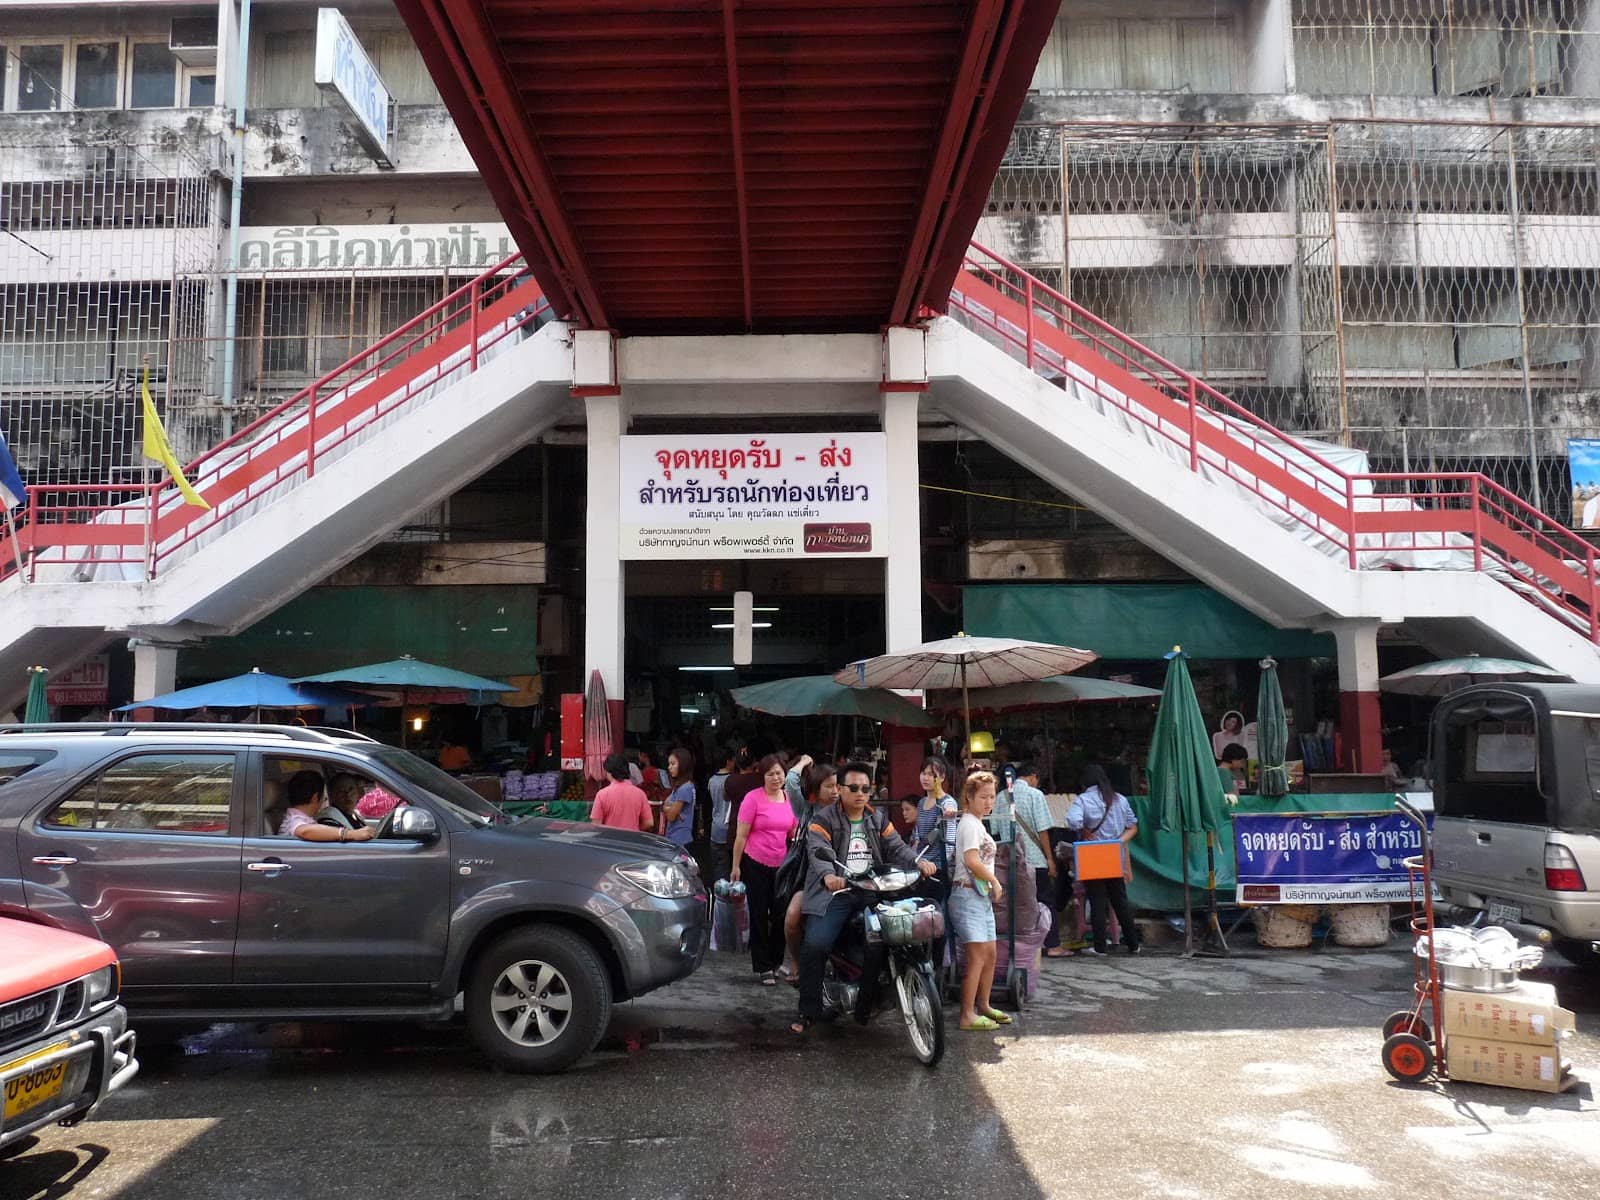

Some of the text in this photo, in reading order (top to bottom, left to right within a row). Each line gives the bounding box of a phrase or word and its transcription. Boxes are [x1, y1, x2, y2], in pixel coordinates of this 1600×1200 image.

[655, 439, 781, 480] จุดหยุดรับ
[819, 439, 852, 467] ส่ง
[639, 472, 869, 504] สำหรับรถนักท่องเที่ยว
[1241, 822, 1324, 862] จุดหยุดรับ
[1339, 822, 1360, 850] ส่ง
[0, 1002, 45, 1030] ISUZU
